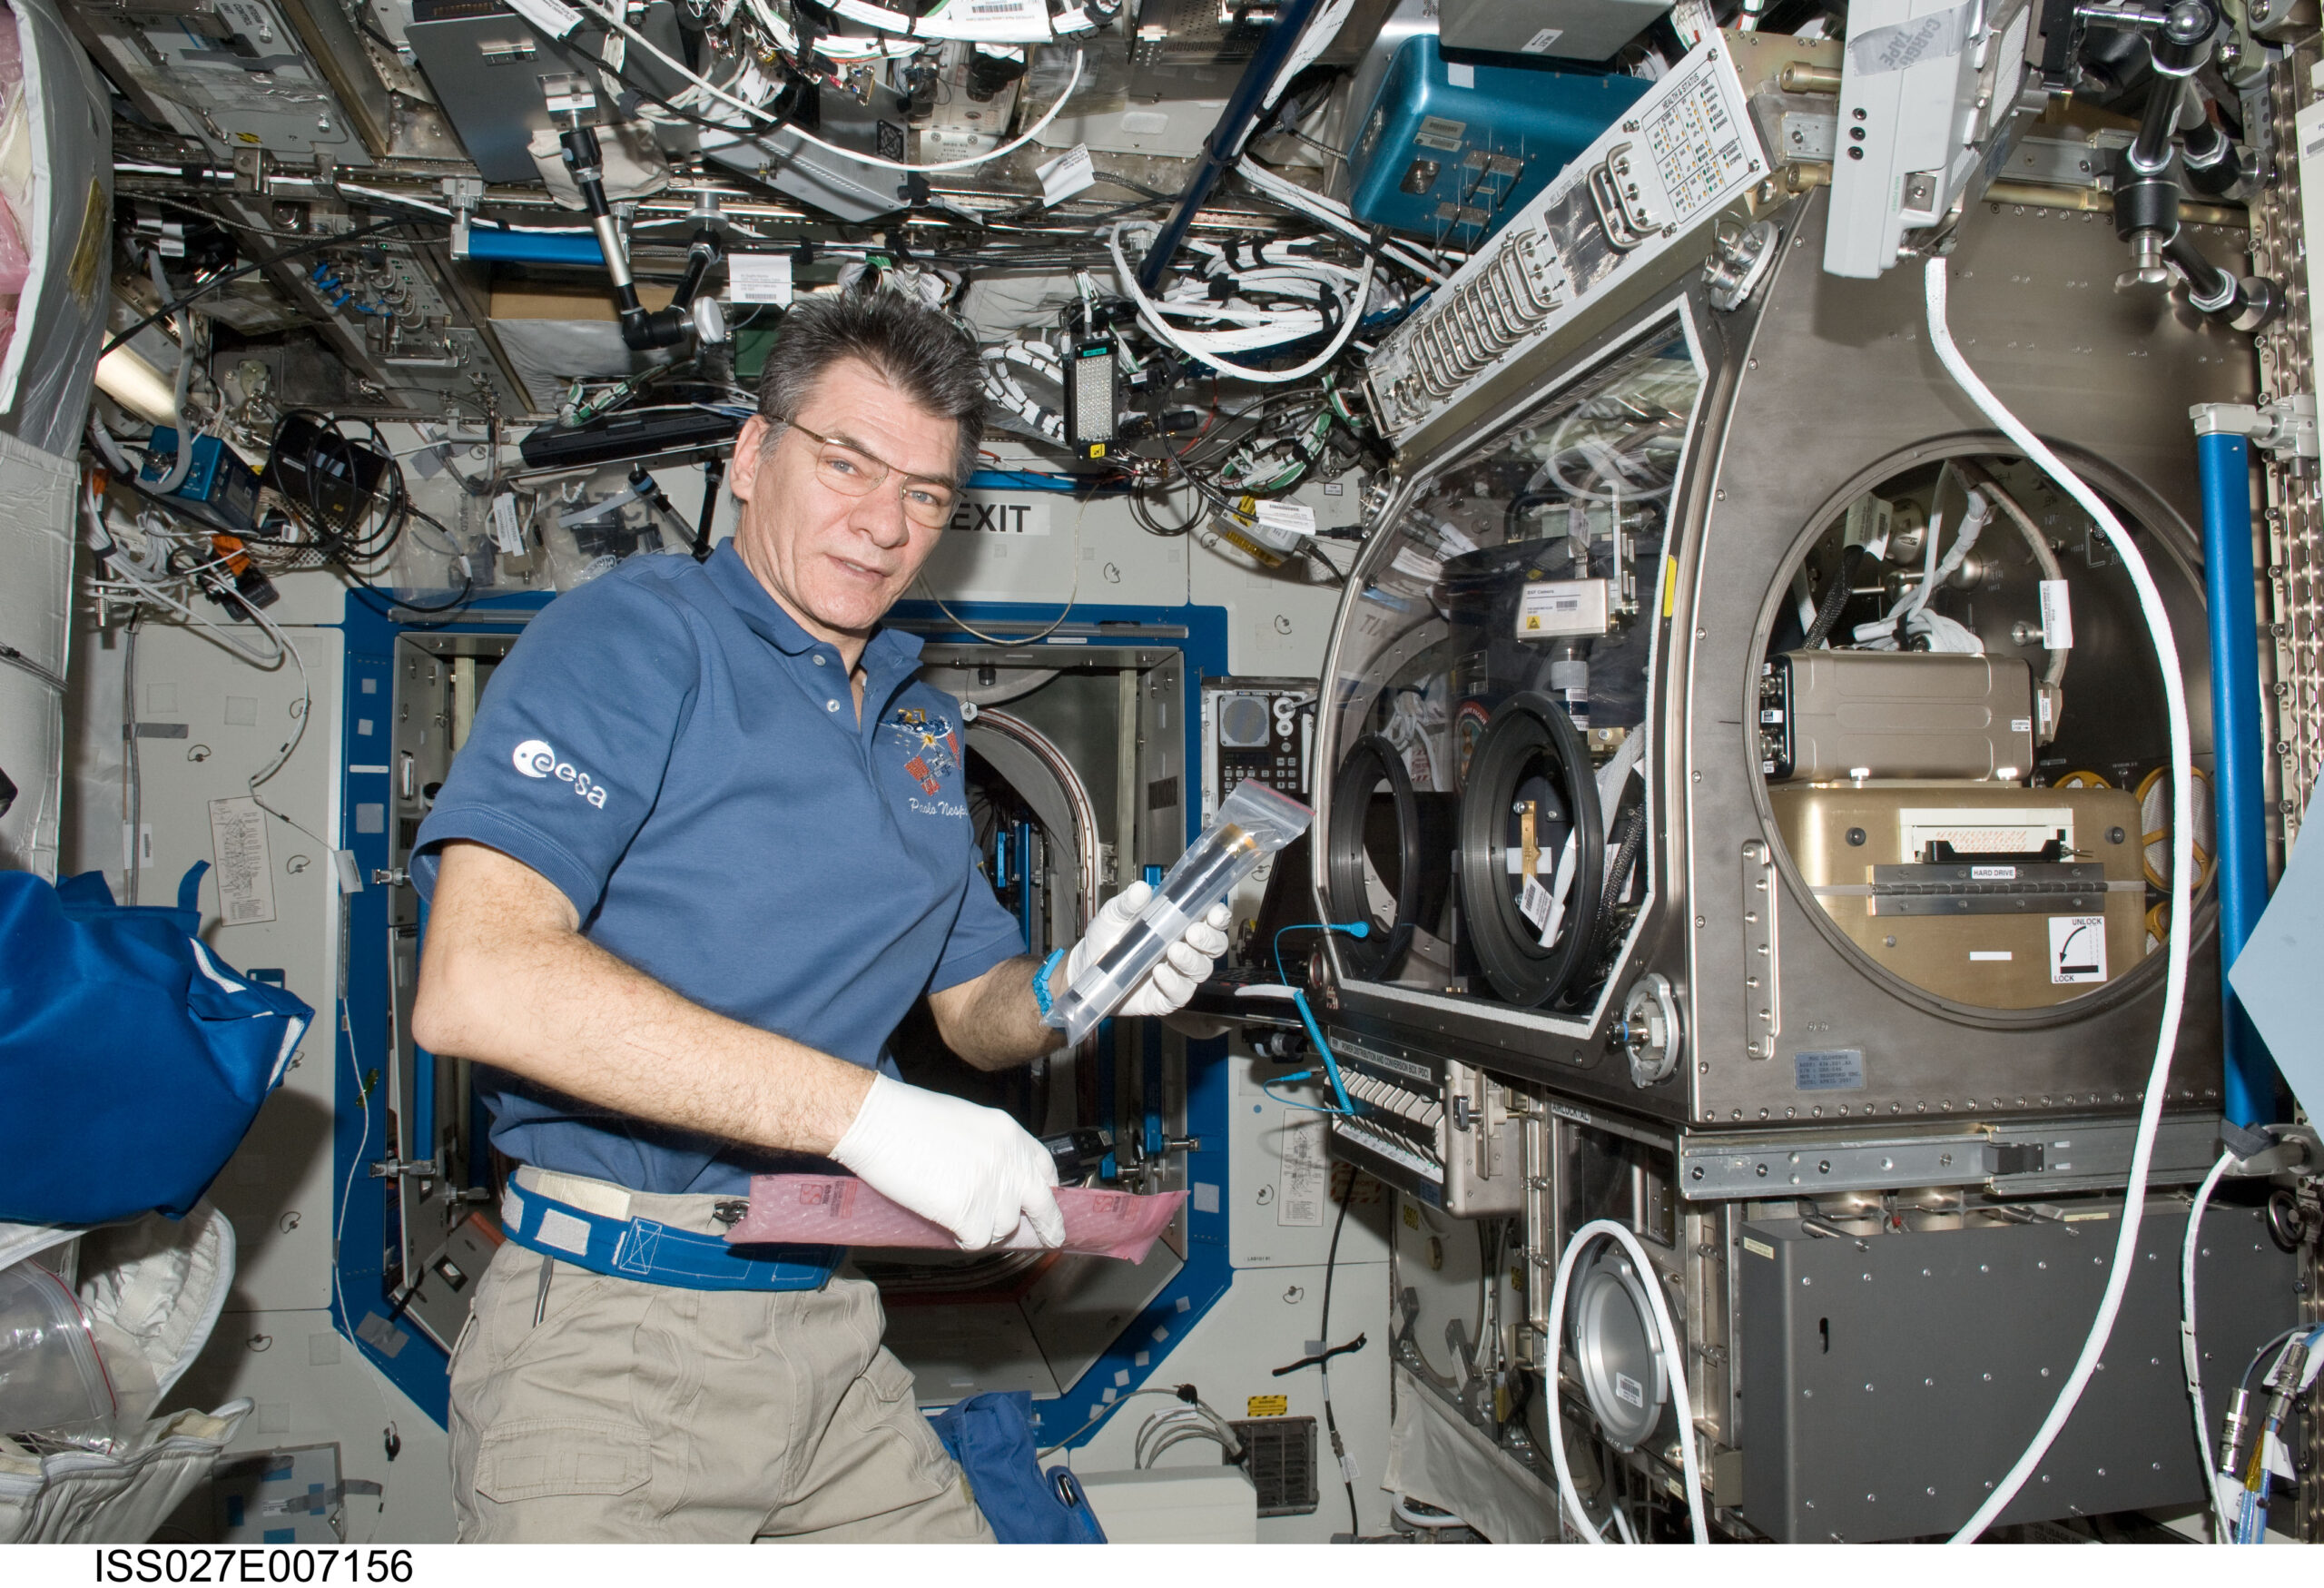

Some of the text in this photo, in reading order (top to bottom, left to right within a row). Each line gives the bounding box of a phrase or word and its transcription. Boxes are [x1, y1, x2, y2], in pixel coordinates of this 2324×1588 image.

[1879, 31, 1913, 66] TAPE
[1899, 18, 1942, 66] CARGO
[1661, 94, 1679, 110] HEALTH
[1682, 73, 1700, 92] STATUS
[950, 503, 1031, 532] EXIT
[898, 708, 925, 724] 27
[909, 798, 937, 815] Paolo
[1974, 869, 1993, 877] HARD
[2072, 917, 2102, 926] UNLOCK
[2054, 974, 2074, 982] LOCK
[1342, 1041, 1354, 1052] POWER
[1353, 1045, 1377, 1062] DISTRIBUTION
[1384, 1056, 1409, 1071] CONVERSION
[1408, 1062, 1418, 1074] BOX
